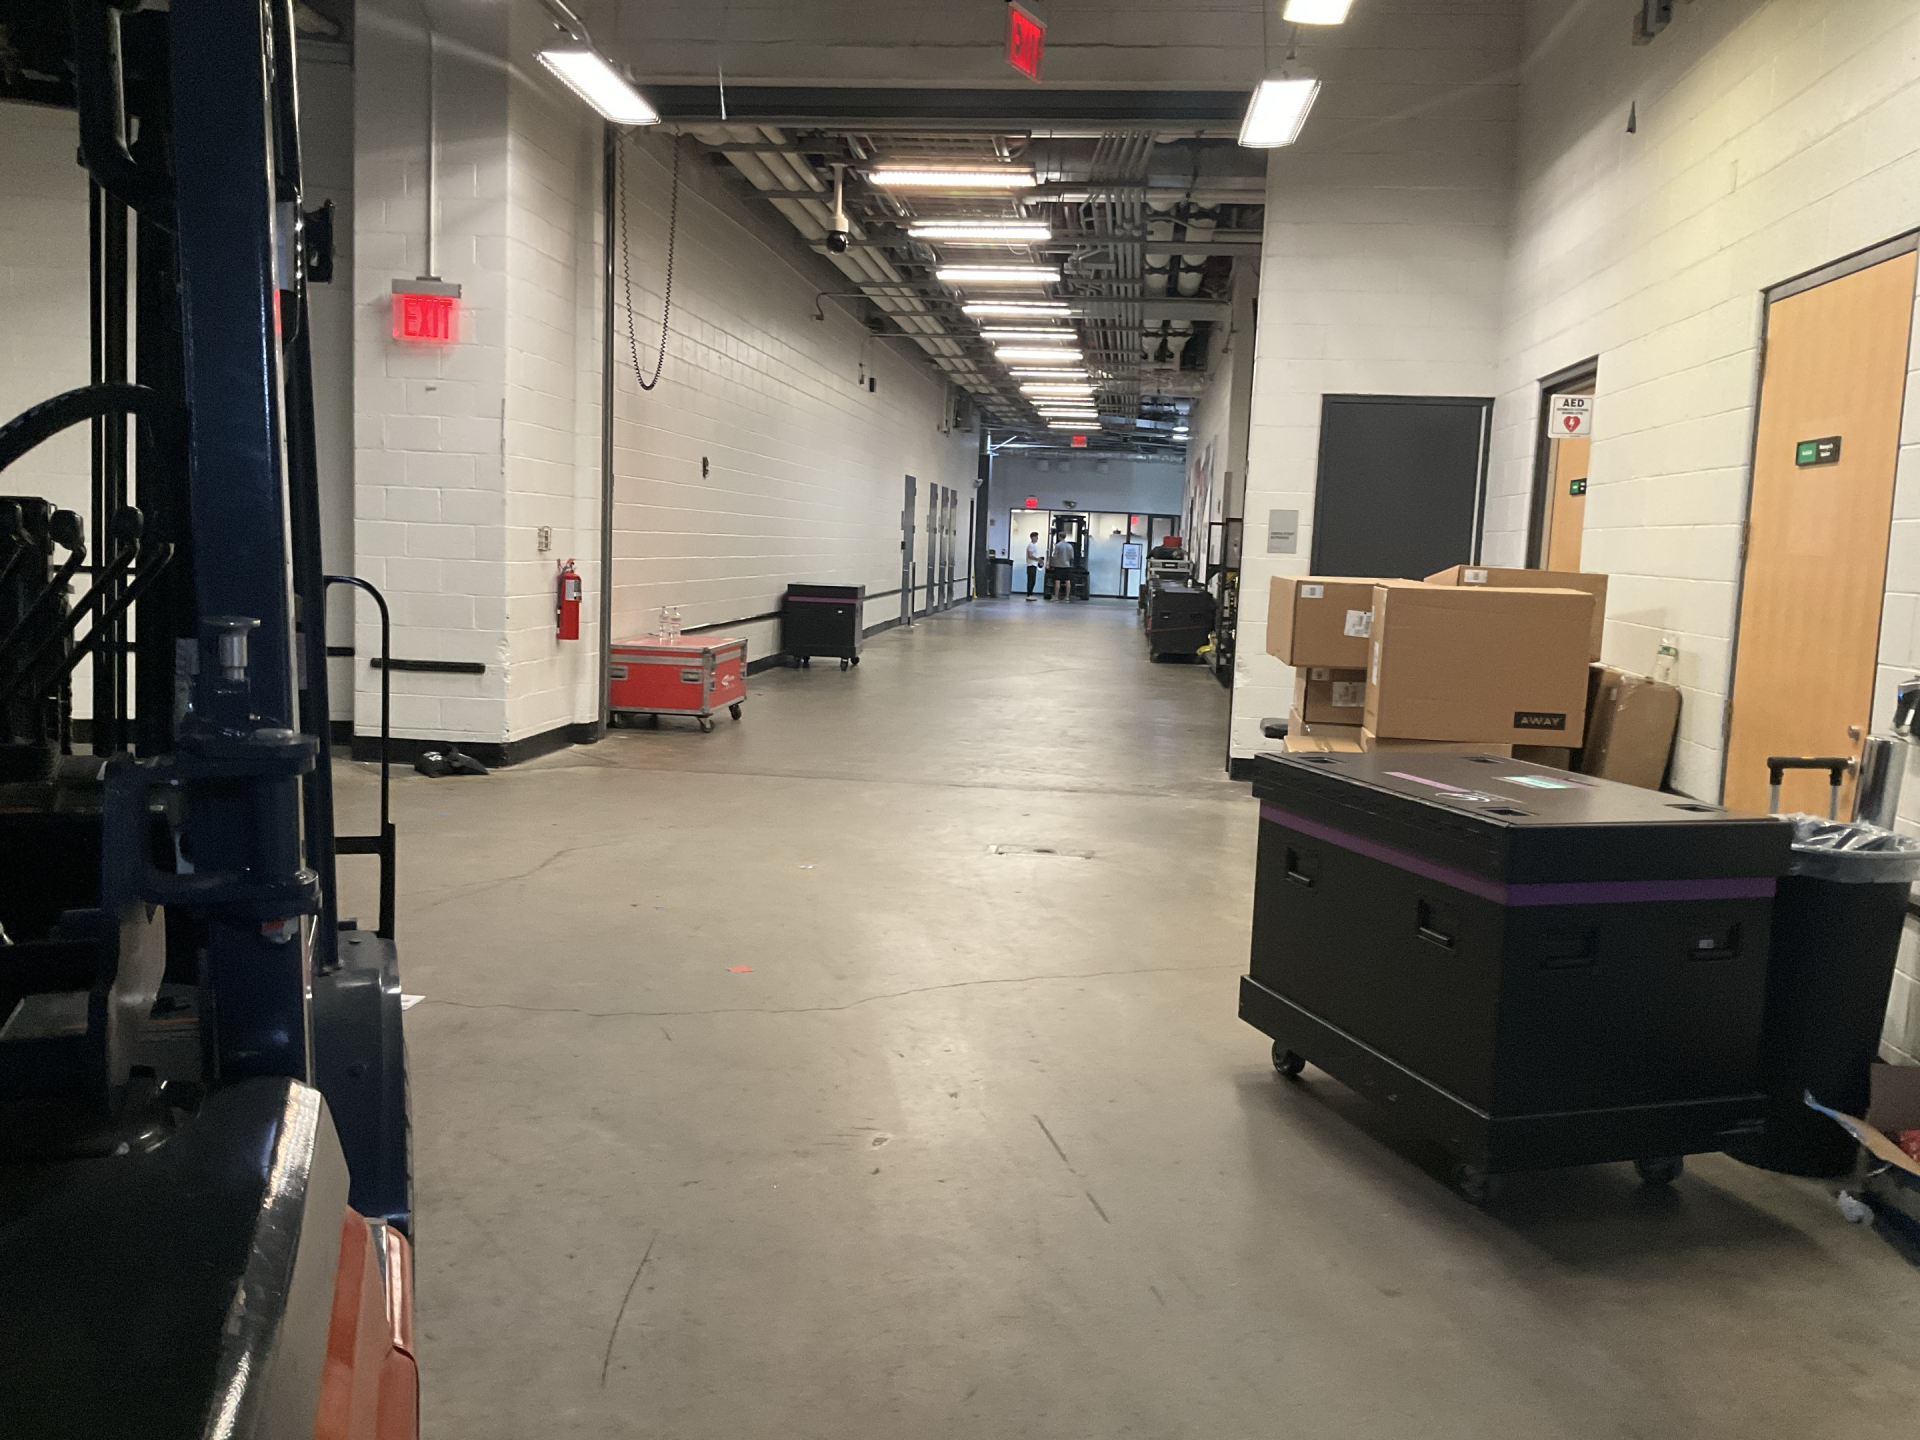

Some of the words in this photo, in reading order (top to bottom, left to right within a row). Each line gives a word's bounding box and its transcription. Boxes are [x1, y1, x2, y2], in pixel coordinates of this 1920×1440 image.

[403, 298, 454, 338] EXIT
[1563, 399, 1584, 407] AED
[1521, 716, 1562, 725] AWAY
